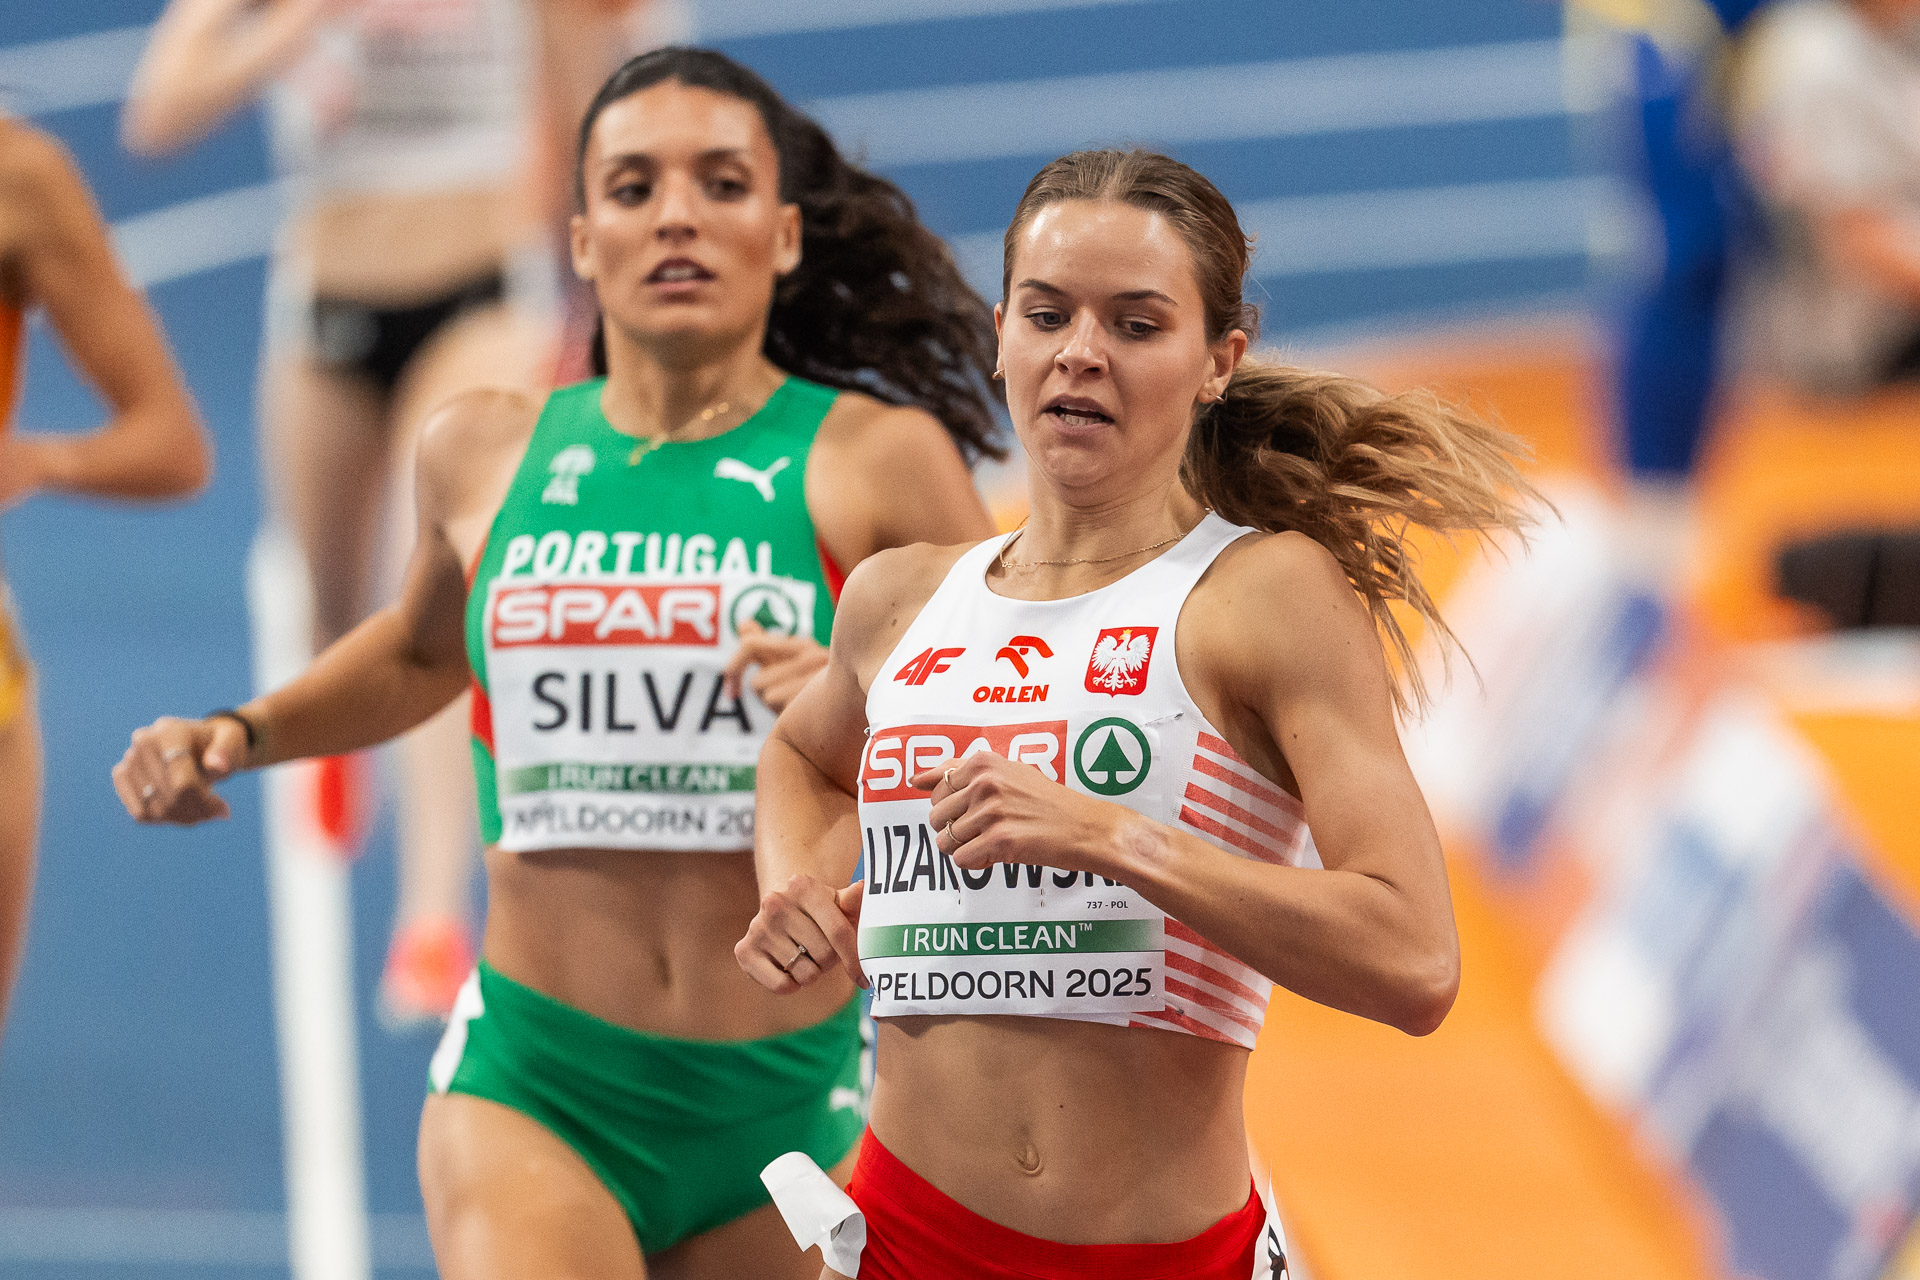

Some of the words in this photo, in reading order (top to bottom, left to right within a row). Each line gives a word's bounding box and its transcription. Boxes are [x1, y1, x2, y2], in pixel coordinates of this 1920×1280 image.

[501, 530, 772, 580] PORTUGAL
[495, 588, 718, 642] SPAR
[893, 647, 966, 685] 4F
[532, 671, 753, 734] SILVA
[972, 684, 1050, 703] ORLEN
[559, 765, 625, 790] RUN
[717, 806, 756, 836] 20
[1086, 901, 1103, 910] 737
[1110, 901, 1129, 910] POL
[902, 928, 909, 952] I
[914, 926, 968, 951] RUN
[1065, 967, 1152, 998] 2025
